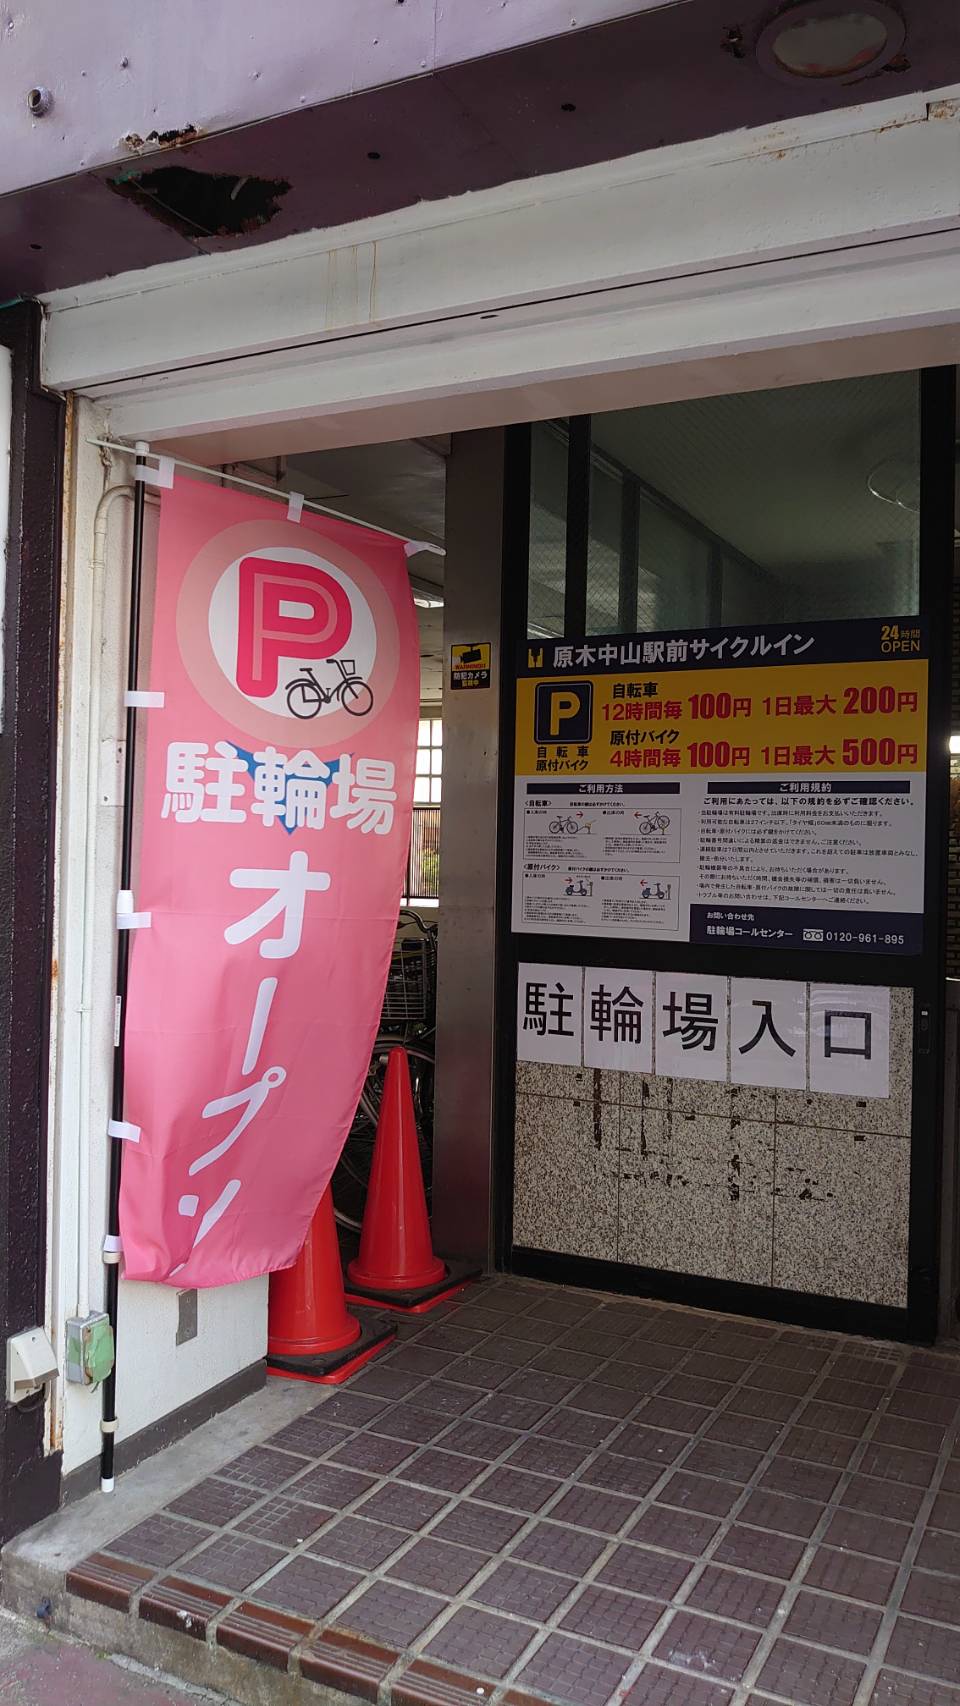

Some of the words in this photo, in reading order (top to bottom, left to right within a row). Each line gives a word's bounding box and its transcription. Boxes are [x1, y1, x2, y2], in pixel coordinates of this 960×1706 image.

[237, 557, 352, 698] P
[881, 624, 920, 641] 24時間
[552, 633, 815, 668] 原木中山駅前サイクルイン
[881, 640, 920, 653] OPEN
[453, 671, 488, 680] 防犯カメラ
[612, 682, 658, 699] 自転車
[550, 691, 581, 736] P
[602, 700, 683, 721] 12時間毎
[688, 692, 752, 720] 100円
[610, 729, 680, 746] 原付バイク
[537, 746, 589, 758] 自転車
[610, 749, 681, 768] 4時間毎
[687, 741, 750, 768] 100円
[536, 759, 589, 772] 原付バイク
[161, 741, 396, 835] 駐輪場
[578, 784, 624, 793] ご利用方法
[780, 782, 832, 792] ご利用規約
[703, 797, 914, 806] ご利用にあたっては、以下の規約を必ずご確認ください。
[707, 912, 754, 921] お問い合わせ先
[707, 925, 793, 938] 駐輪場コールセンター
[826, 932, 904, 945] 0120-961-895
[522, 982, 873, 1060] 駐輪場入口
[180, 850, 331, 1276] オープン
